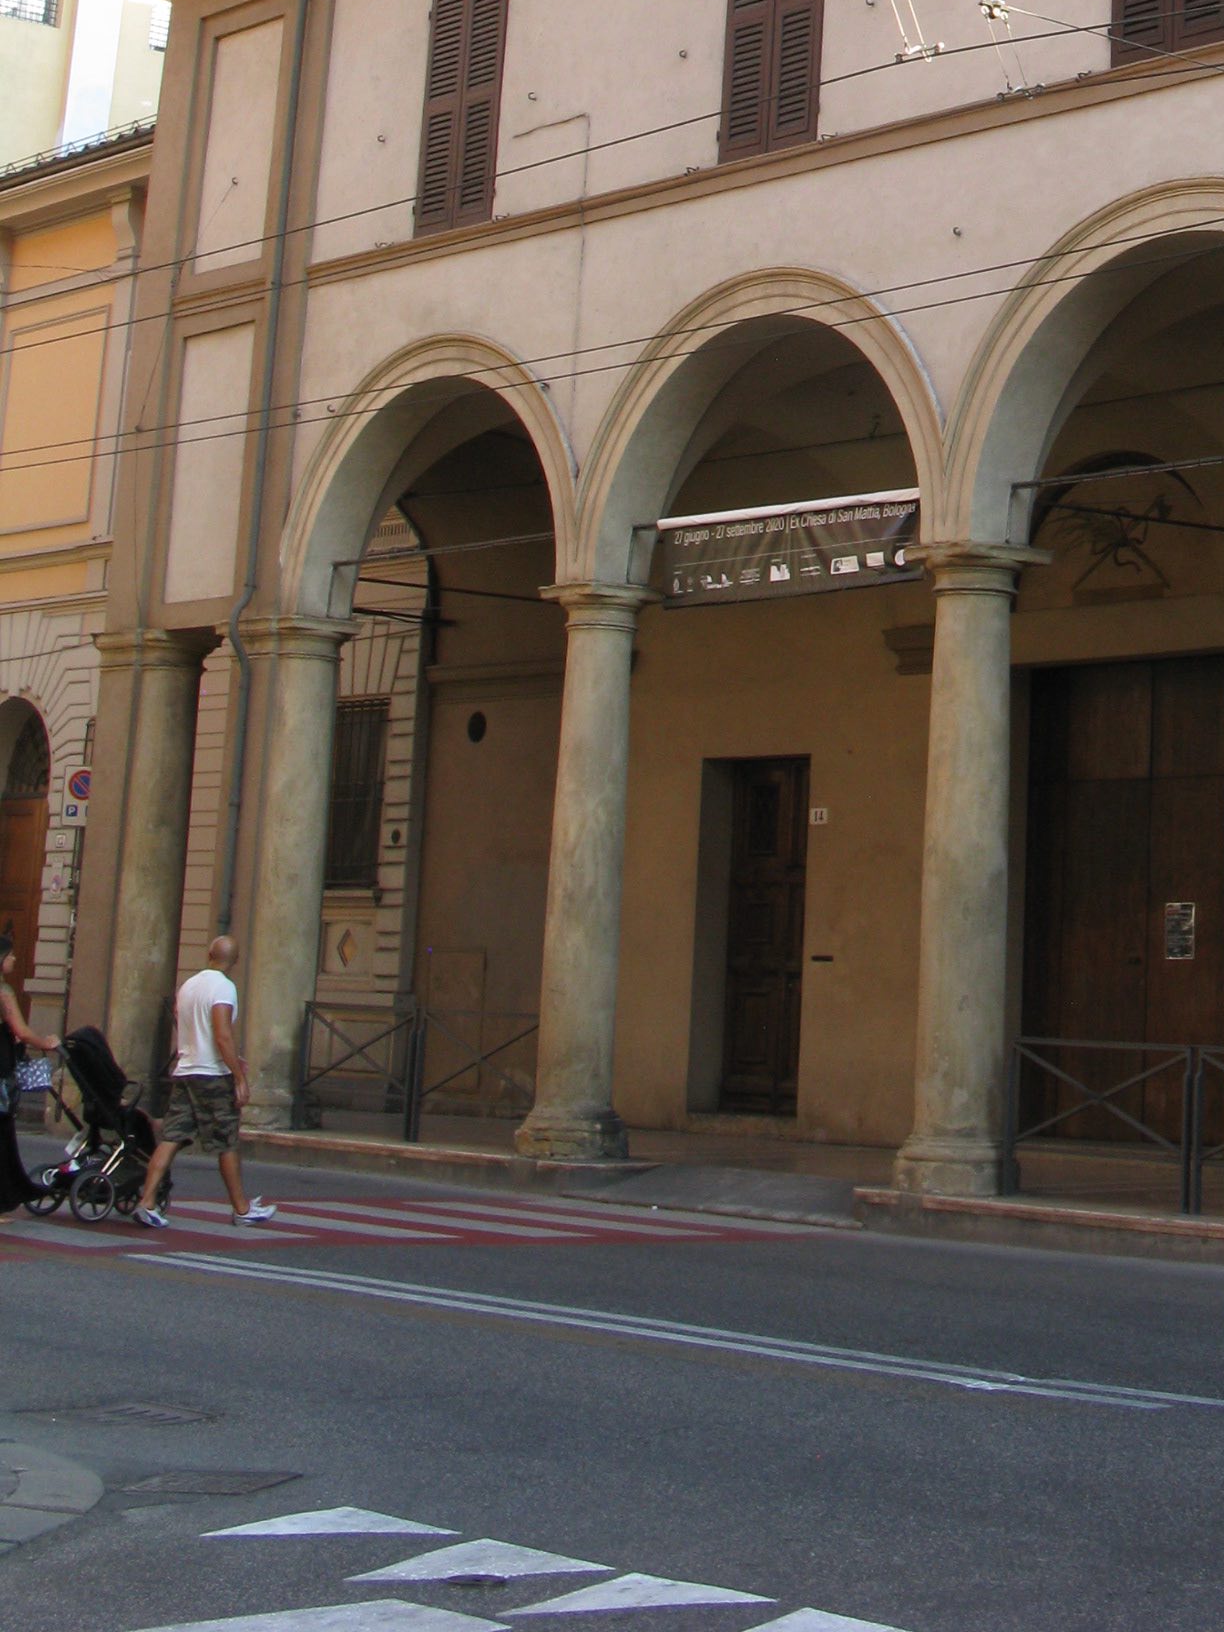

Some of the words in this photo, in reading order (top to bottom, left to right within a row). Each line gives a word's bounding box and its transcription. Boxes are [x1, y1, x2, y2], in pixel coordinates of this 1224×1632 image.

[674, 530, 683, 545] 27
[684, 529, 710, 546] giugno
[716, 525, 725, 539] 27
[726, 521, 764, 538] settembre
[766, 517, 785, 533] 2020
[790, 514, 800, 529] Ex
[801, 511, 827, 528] Chiesa
[828, 510, 836, 524] di
[837, 508, 853, 523] San
[854, 505, 881, 520] Mattia,
[882, 502, 915, 518] Bologna
